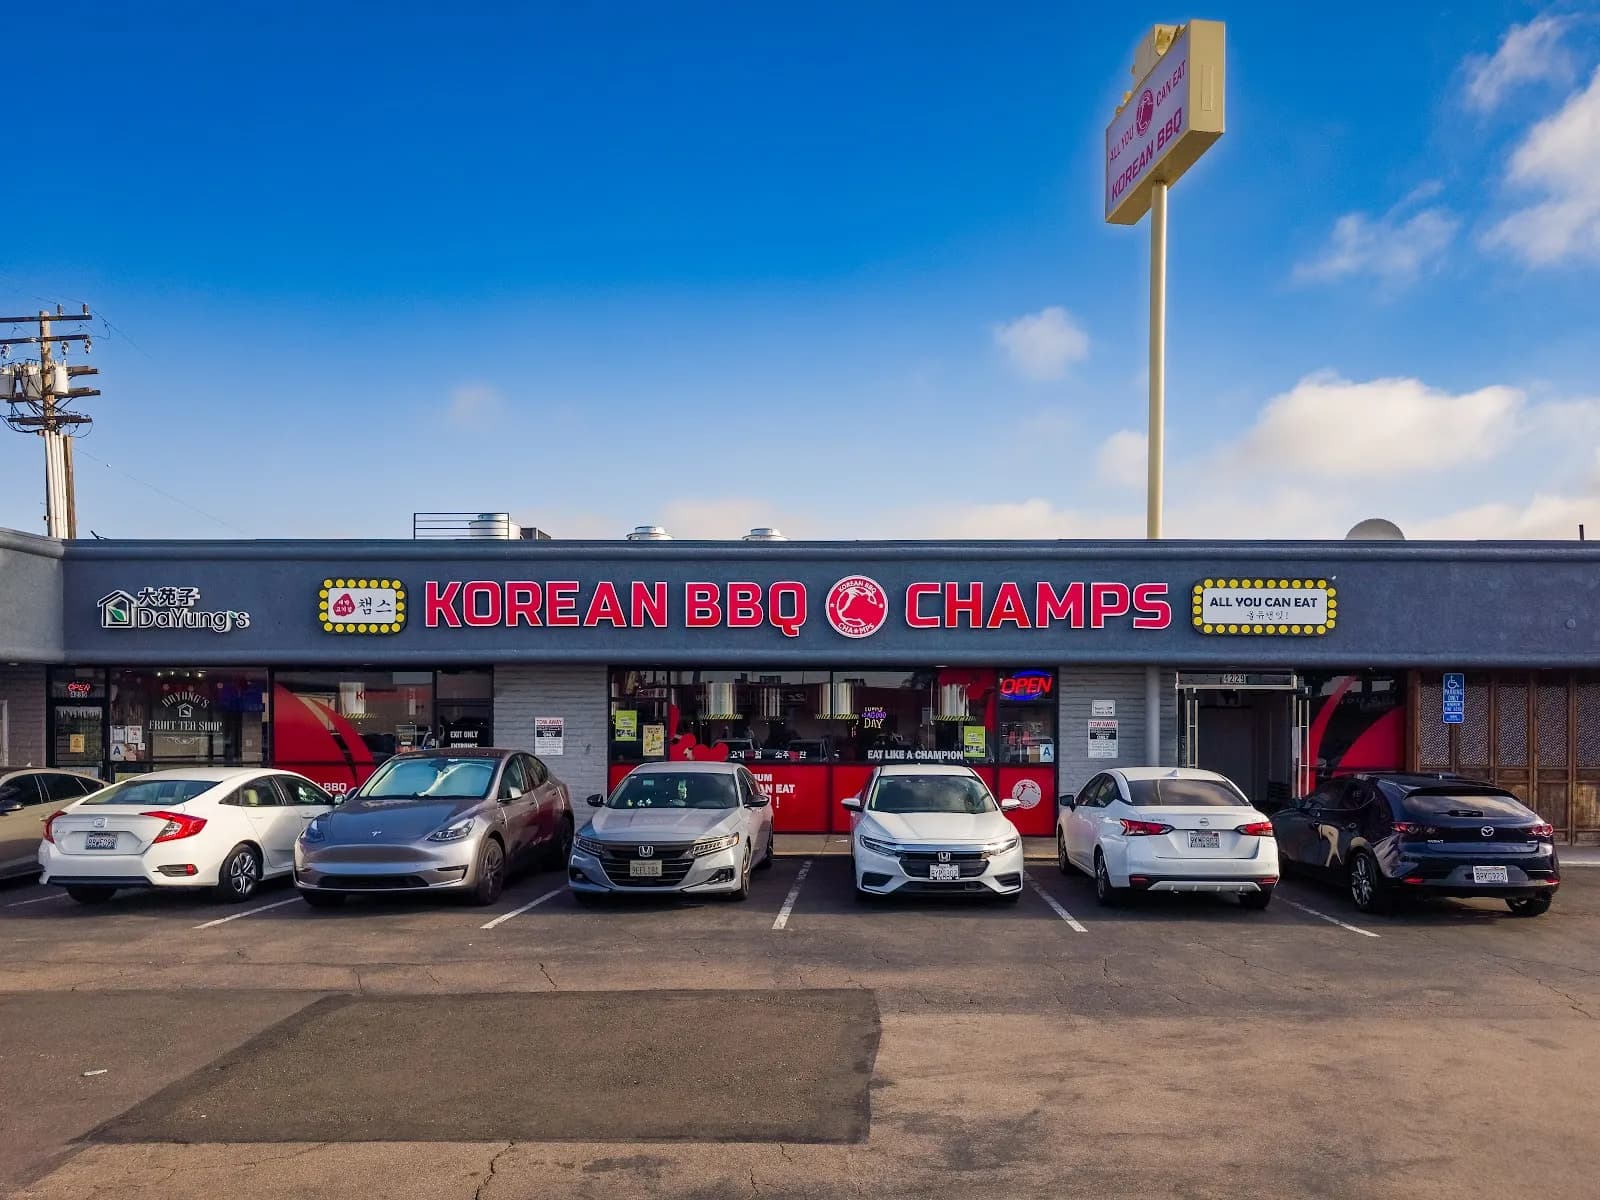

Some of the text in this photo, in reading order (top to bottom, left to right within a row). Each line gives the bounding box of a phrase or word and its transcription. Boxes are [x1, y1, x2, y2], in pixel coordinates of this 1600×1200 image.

[1156, 60, 1186, 107] CAN EAT
[1110, 124, 1134, 161] ALL YOU
[1111, 107, 1182, 202] KOREAN BBQ
[838, 580, 877, 593] KOREAN BBQ
[1209, 597, 1318, 608] ALL YOU CAN EAT
[425, 580, 1172, 638] KOREAN BBQ CHAMPS
[137, 607, 250, 632] DaYung's
[67, 682, 91, 692] OPEN
[1001, 676, 1053, 694] OPEN
[161, 691, 210, 708] DAYUNG'S
[149, 719, 223, 732] FRUIT TEA SHOP
[864, 718, 884, 729] DAY
[450, 730, 479, 738] EXIT ONLY
[113, 745, 121, 755] A
[868, 750, 964, 760] EAT LIKE A CHAMPION
[1043, 746, 1051, 756] A
[323, 782, 347, 793] BBQ
[775, 784, 796, 794] EAT
